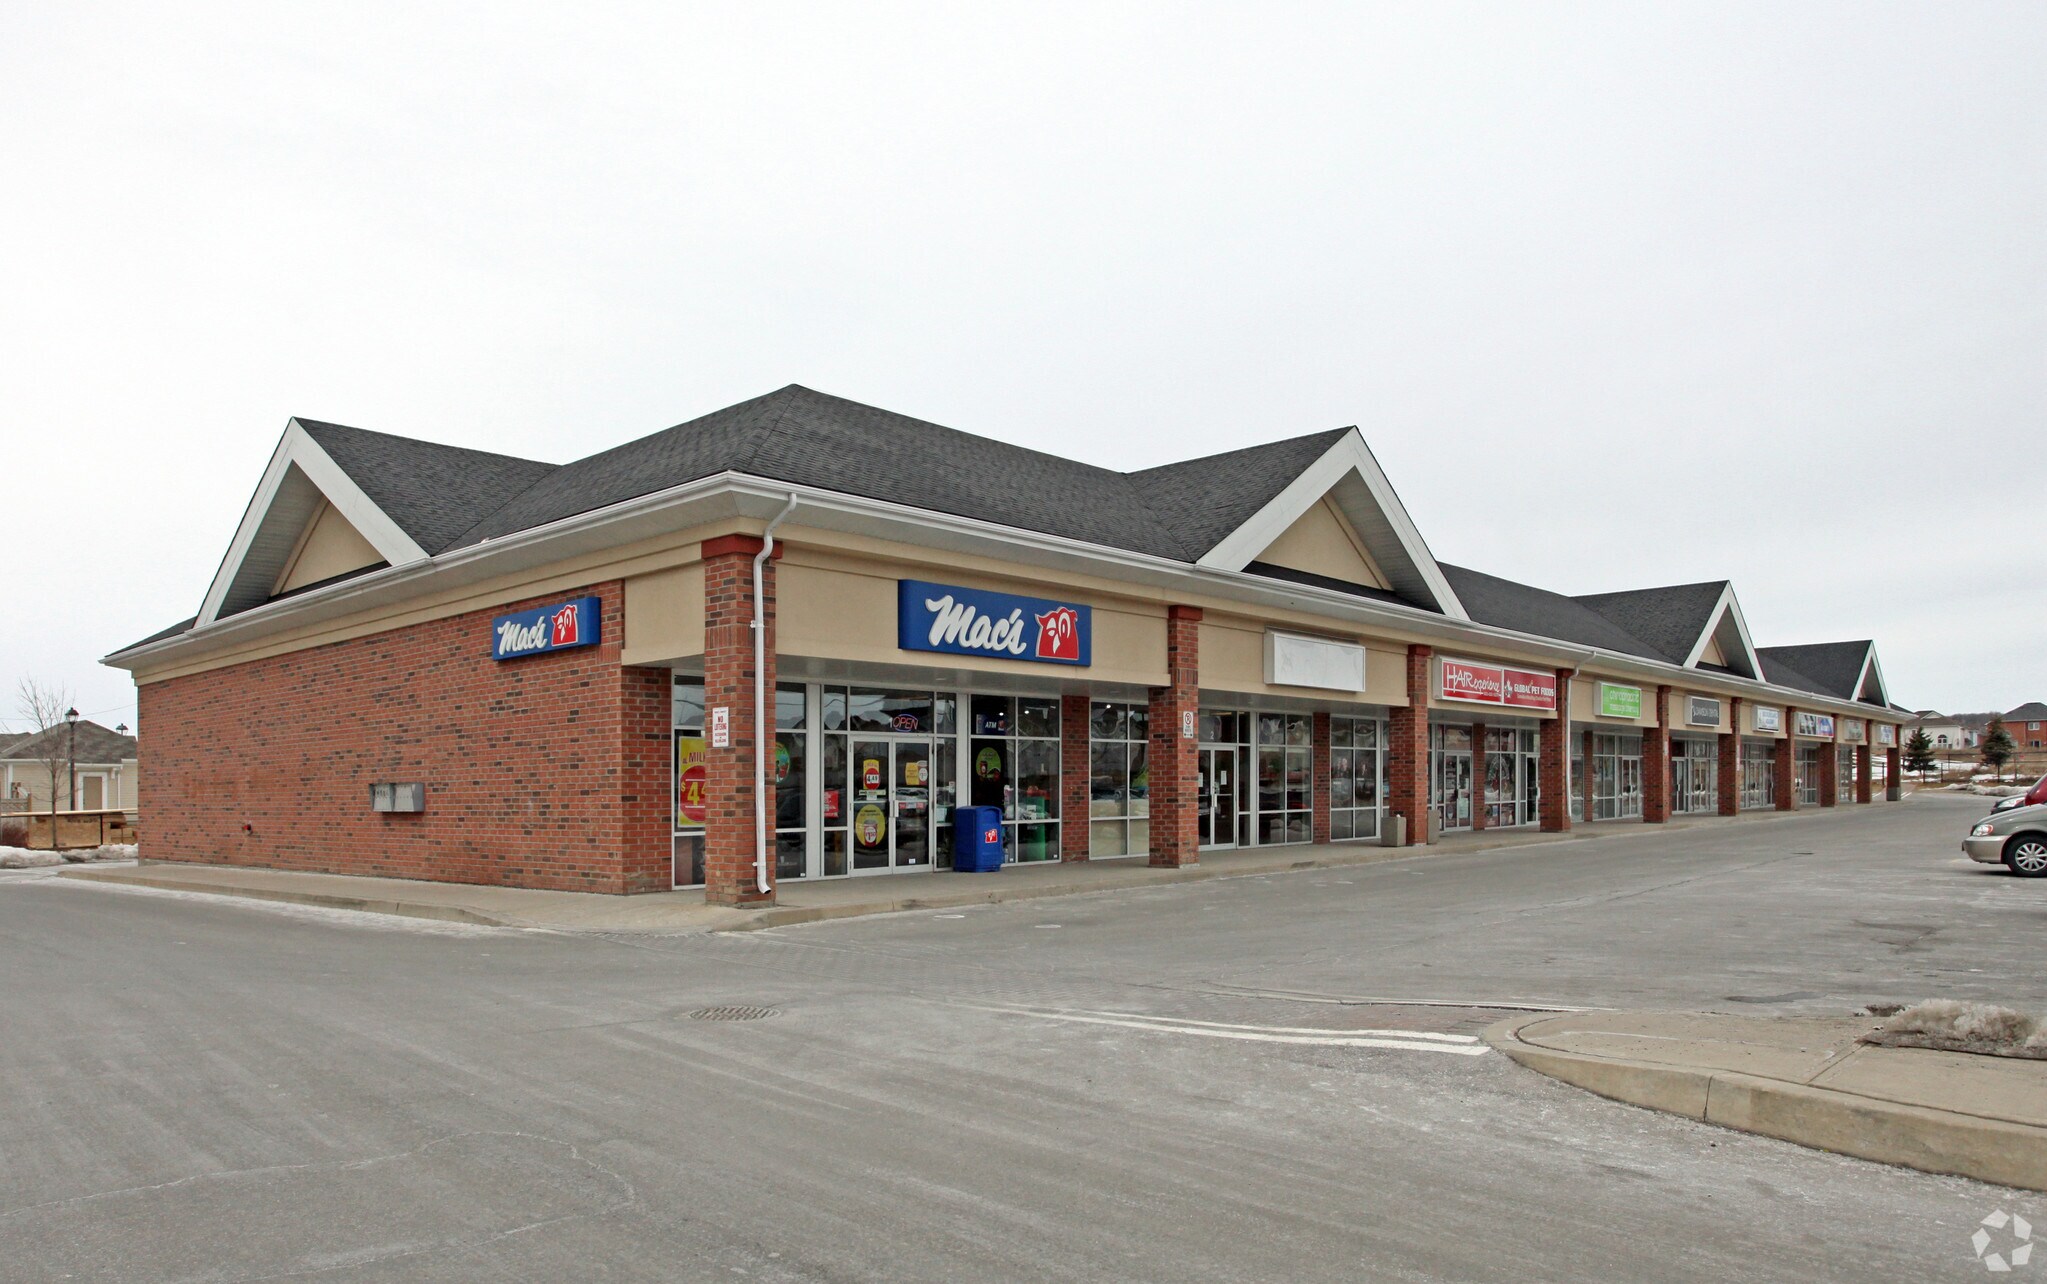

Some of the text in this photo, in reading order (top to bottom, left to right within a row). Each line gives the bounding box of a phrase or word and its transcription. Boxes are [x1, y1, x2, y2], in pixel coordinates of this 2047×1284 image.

[497, 615, 548, 655] Mac's
[925, 594, 1027, 655] Mac's
[1513, 683, 1554, 697] GLOBAL PET FOODS
[892, 716, 919, 730] OPEN
